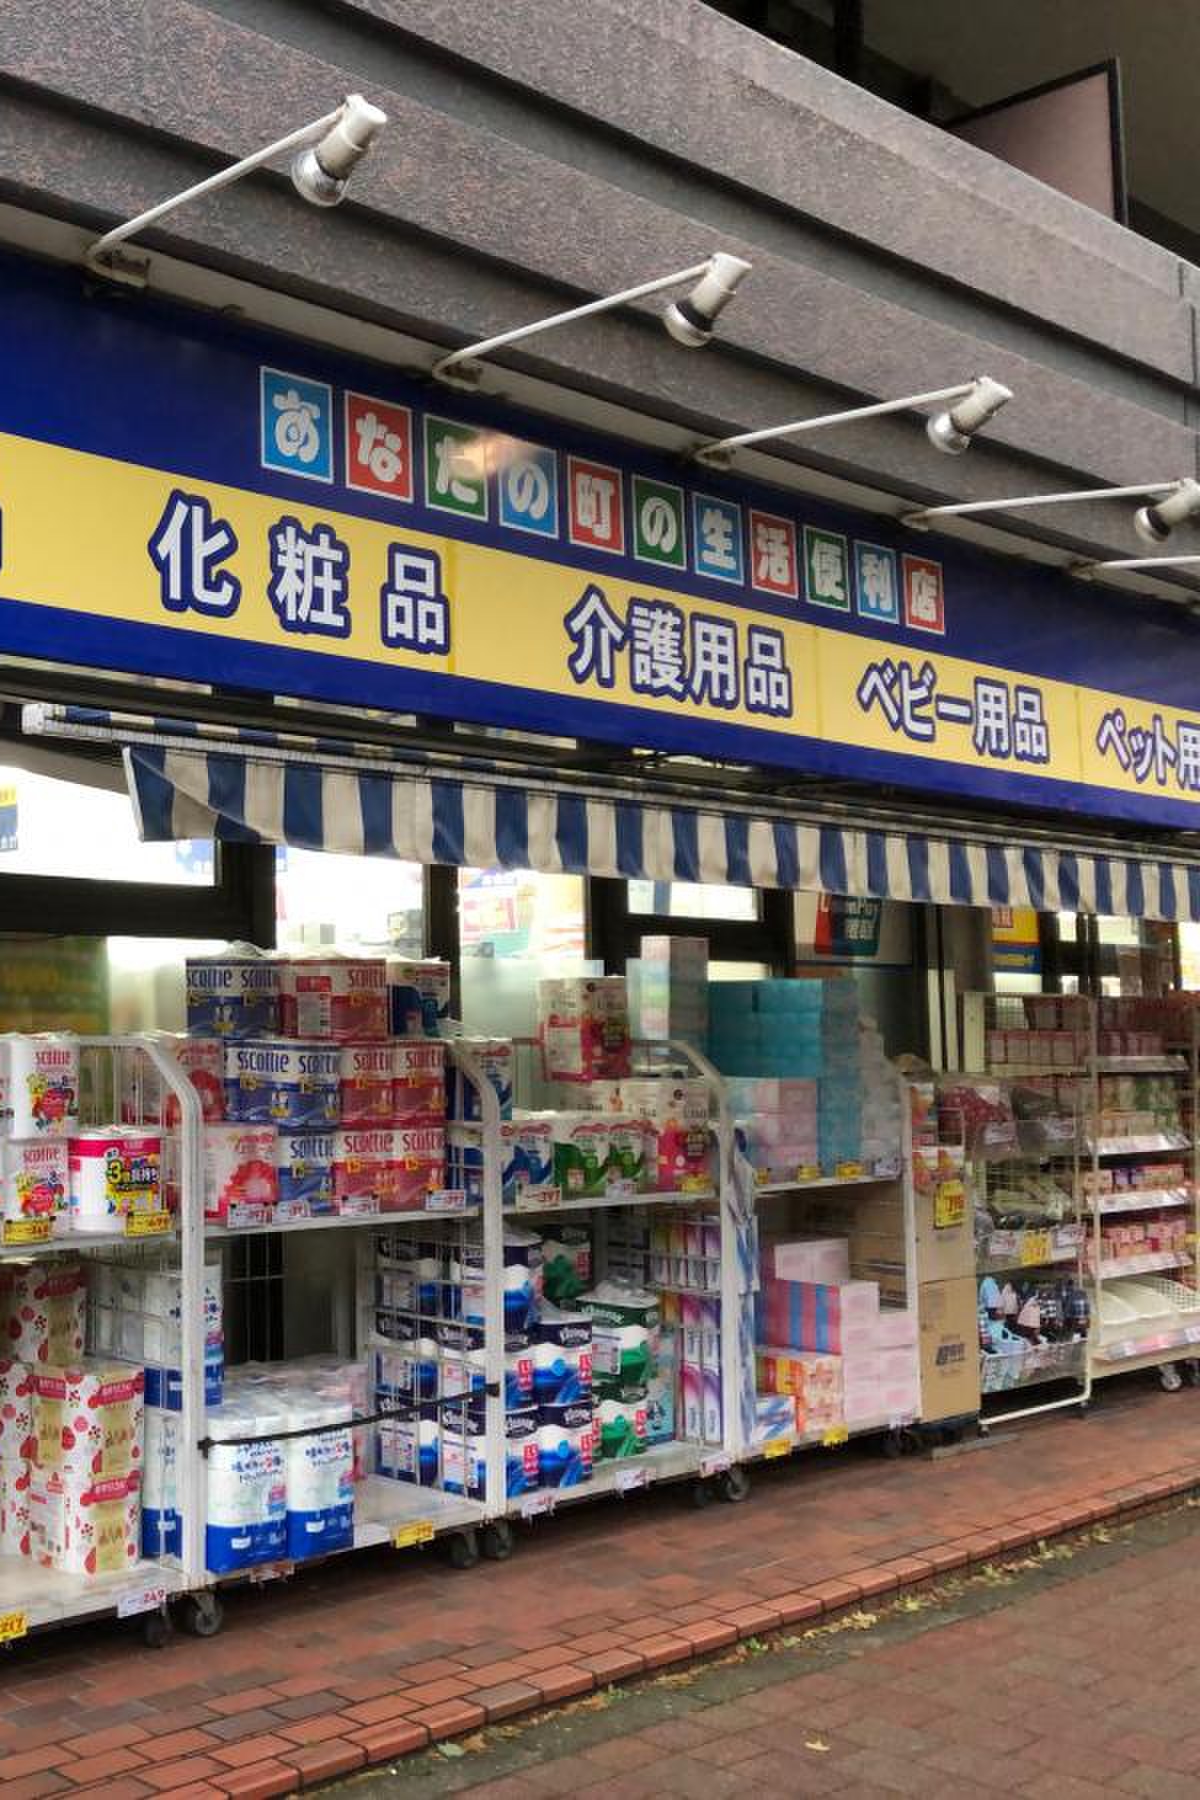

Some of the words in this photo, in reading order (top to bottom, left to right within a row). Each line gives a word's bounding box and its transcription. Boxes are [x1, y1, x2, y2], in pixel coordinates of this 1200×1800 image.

[154, 496, 447, 650] 化粧品
[566, 588, 791, 714] 介護用品
[860, 662, 1049, 760] ベビー用品
